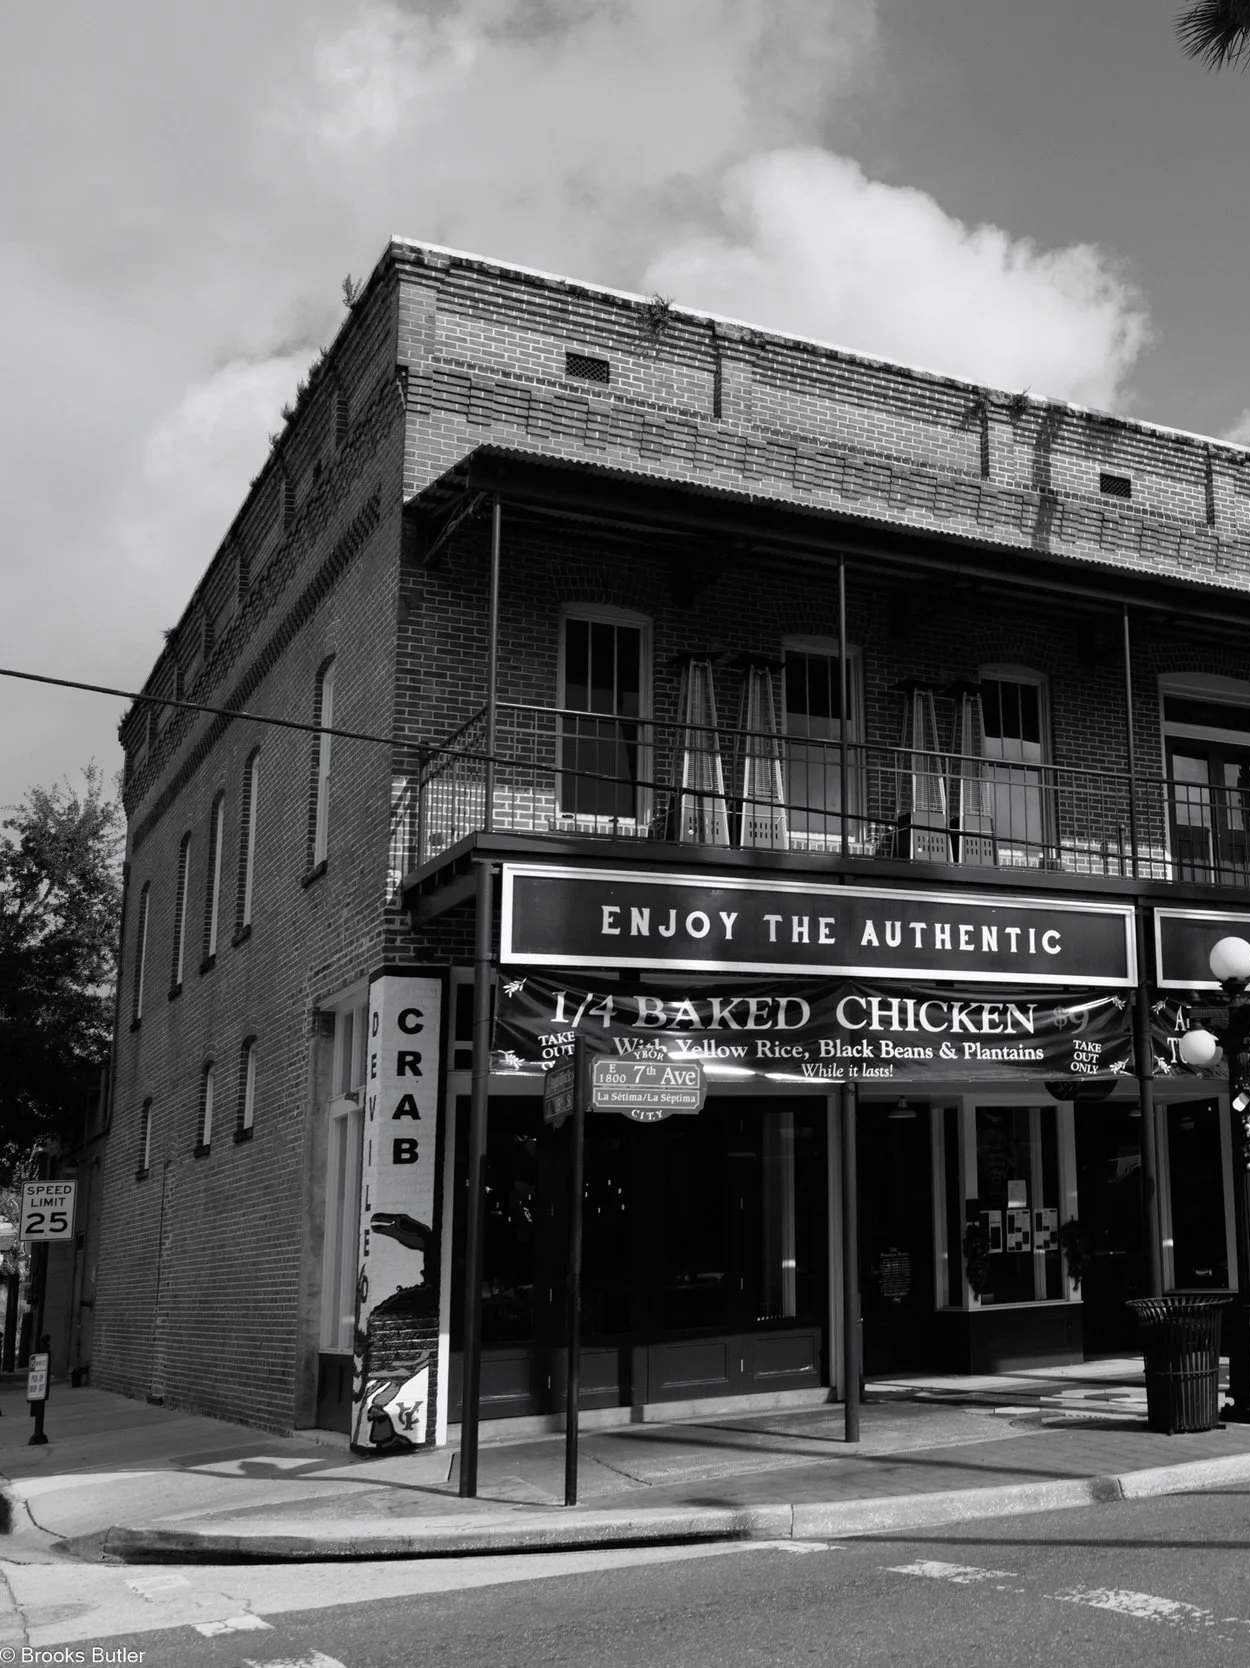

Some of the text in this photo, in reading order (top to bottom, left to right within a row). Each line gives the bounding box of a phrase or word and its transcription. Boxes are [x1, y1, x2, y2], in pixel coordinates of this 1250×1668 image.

[601, 905, 1062, 954] ENJOY THE AUTHENTIC
[551, 991, 617, 1028] 1/4
[632, 995, 811, 1030] BAKED
[836, 995, 1038, 1034] CHICKEN
[538, 1031, 575, 1046] TAKE
[542, 1044, 575, 1059] OUT
[675, 1039, 748, 1059] Yellow
[755, 1040, 809, 1059] Rice,
[818, 1039, 875, 1058] Black
[879, 1040, 933, 1059] Beans
[939, 1041, 958, 1060] &
[962, 1042, 1044, 1061] Plantains
[1073, 1040, 1101, 1053] TAKE
[633, 1049, 664, 1061] YBOR
[1073, 1051, 1099, 1064] OUT
[609, 1063, 617, 1073] E
[802, 1063, 893, 1078] While it lasts!
[1070, 1062, 1098, 1075] ONLY
[599, 1074, 627, 1083] 1800
[633, 1065, 696, 1085] 7th Ave
[391, 1007, 425, 1165] CRAB
[597, 1092, 609, 1101] La
[631, 1109, 663, 1120] CITY
[27, 1185, 72, 1195] SPEED
[31, 1197, 66, 1207] LIMIT
[25, 1211, 68, 1234] 25
